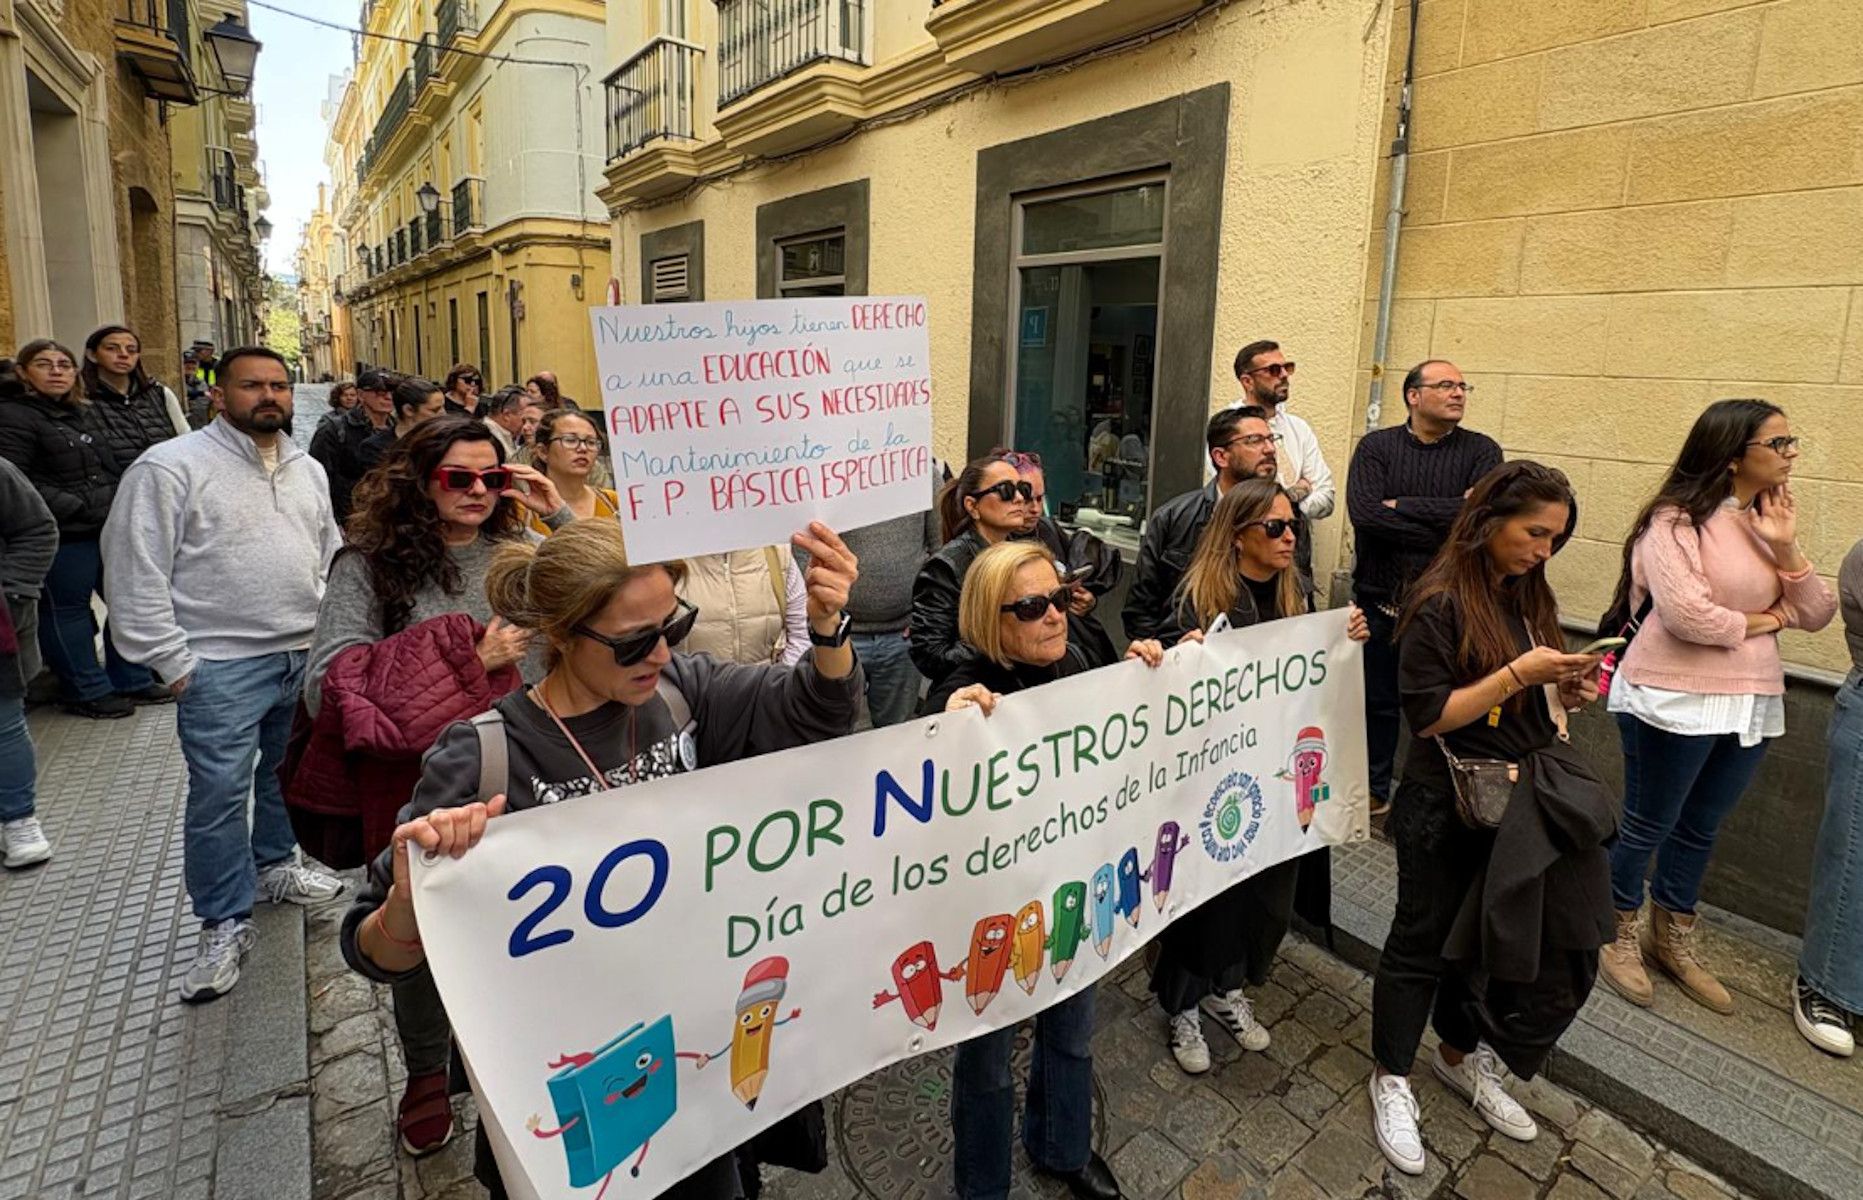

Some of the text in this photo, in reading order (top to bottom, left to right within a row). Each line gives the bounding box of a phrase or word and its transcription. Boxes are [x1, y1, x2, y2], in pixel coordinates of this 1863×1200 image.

[598, 303, 926, 345] Nuestros hijos tienen DERECHO
[605, 342, 916, 391] a una EDUCACIÓN que se
[610, 377, 931, 436] ADAPTE A SUS NECESIDADES
[621, 421, 911, 479] Mantenimiento de la
[710, 466, 815, 513] BÁSICA
[820, 445, 929, 499] ESPECÍFICA
[507, 650, 1327, 958] 20 POR NUESTROS DERECHOS
[728, 896, 804, 958] Día
[822, 871, 874, 918] de
[892, 854, 949, 896] los
[966, 795, 1108, 876] derechos
[1115, 774, 1141, 811] de
[1149, 762, 1167, 794] la
[1175, 723, 1258, 782] Infancia
